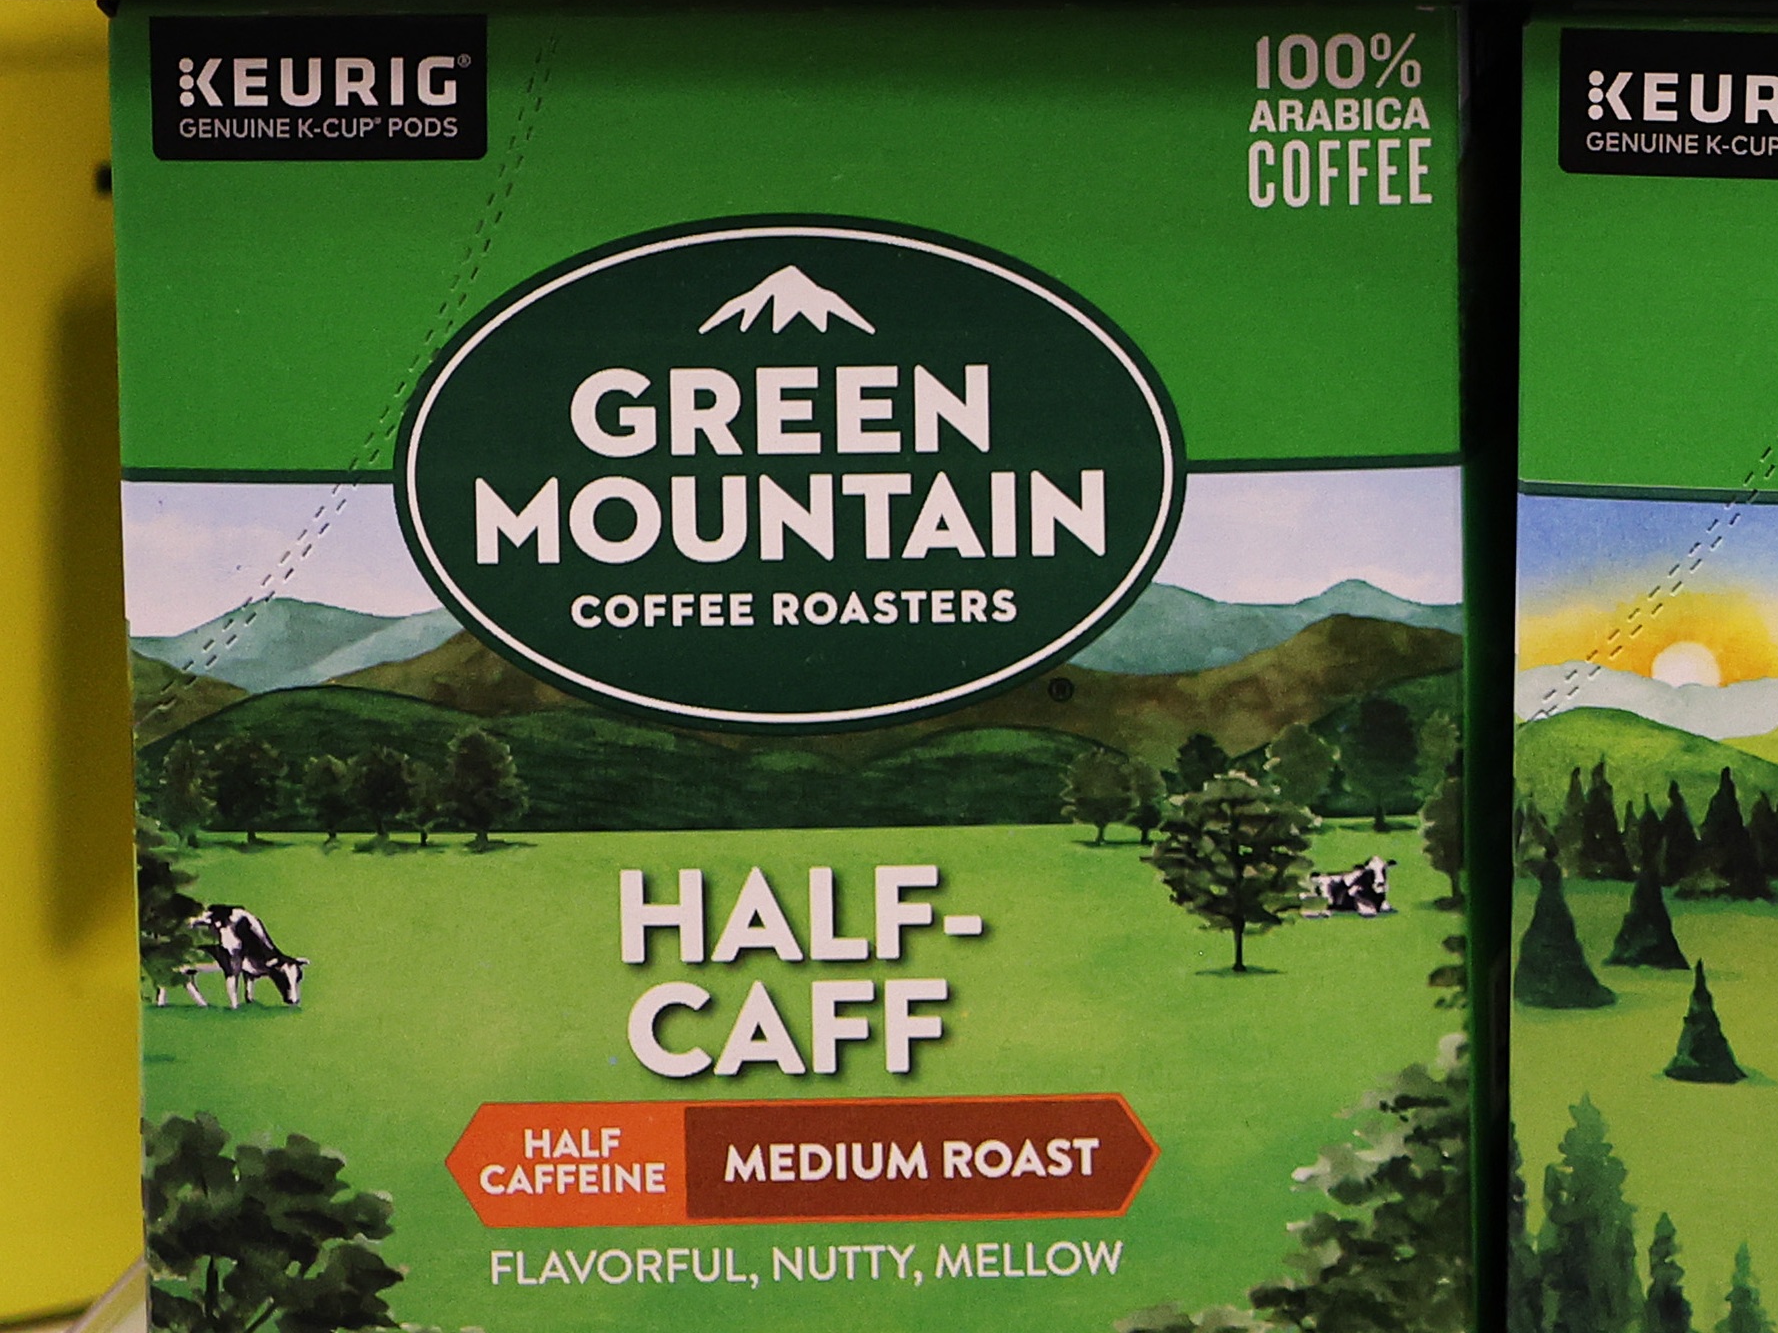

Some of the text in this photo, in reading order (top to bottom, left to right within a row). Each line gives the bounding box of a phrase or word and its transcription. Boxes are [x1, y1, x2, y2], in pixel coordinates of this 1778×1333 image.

[1256, 33, 1422, 89] 100%
[1249, 97, 1430, 132] ARABICA
[1248, 138, 1432, 208] COFFEE
[570, 363, 990, 458] GREEN
[475, 469, 1106, 564] MOUNTAIN
[571, 589, 1017, 629] COFFEE ROASTERS
[619, 865, 984, 964] HALF-
[627, 979, 949, 1078] CAFF
[524, 1128, 621, 1159] HALF
[724, 1138, 1099, 1183] MEDIUM ROAST
[479, 1162, 667, 1195] CAFFEINE
[490, 1241, 1124, 1289] FLAVORFUL, NUTTY, MELLOW
